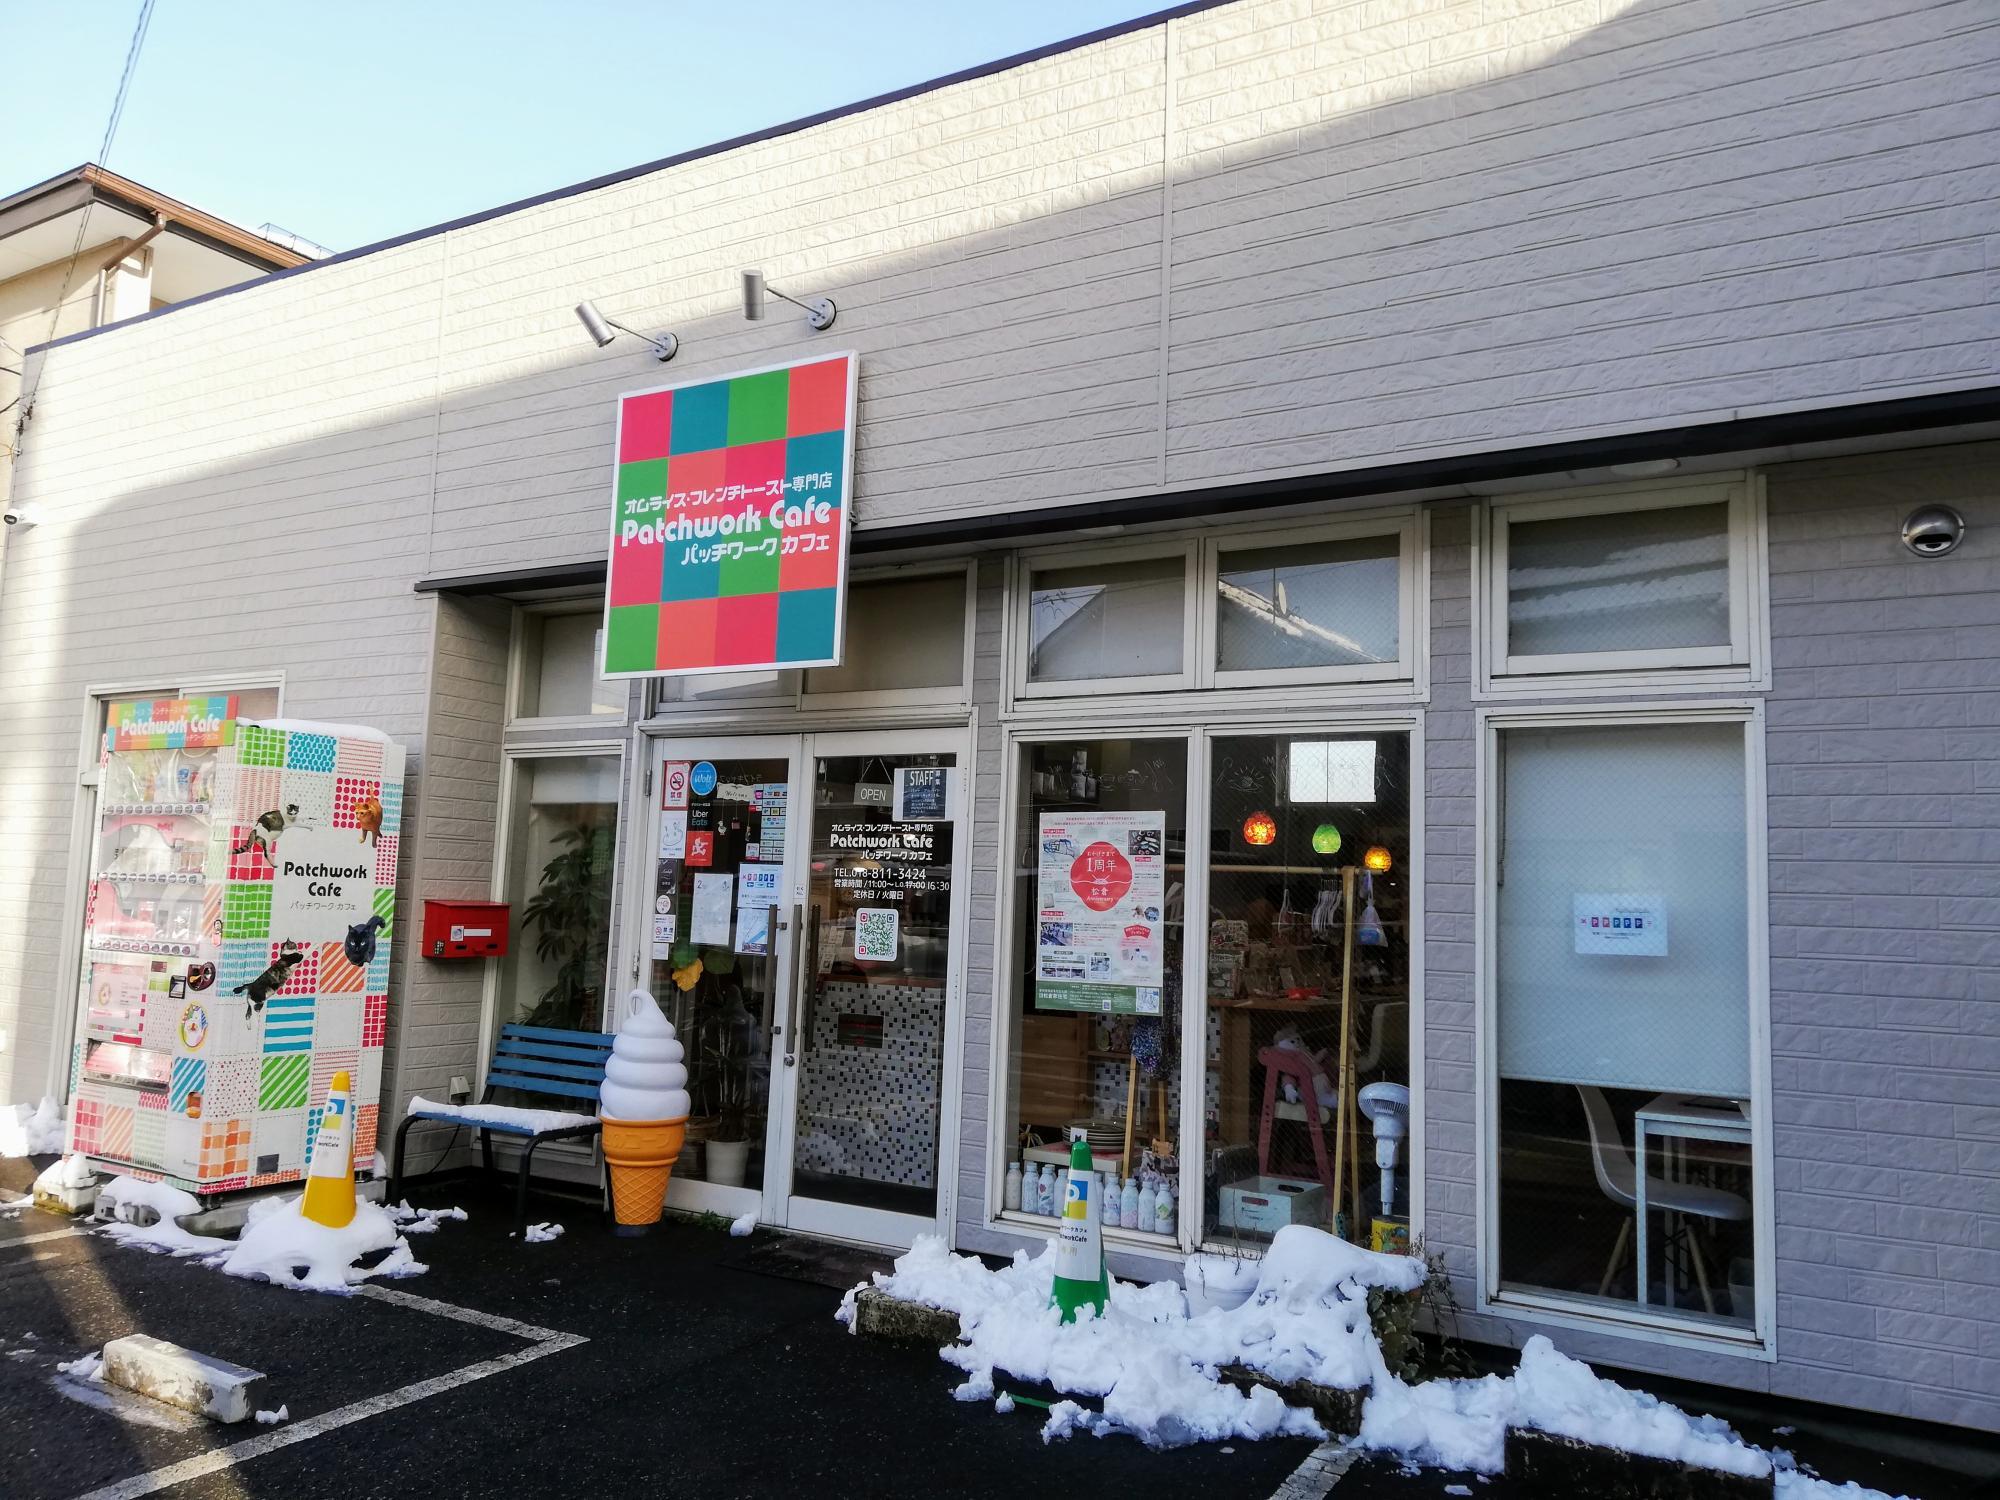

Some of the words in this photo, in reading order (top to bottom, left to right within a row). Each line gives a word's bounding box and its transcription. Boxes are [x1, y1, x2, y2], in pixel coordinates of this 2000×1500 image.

[625, 472, 833, 515] オムライス・フレンチトースト専門店
[621, 504, 761, 547] Patchwork
[769, 495, 832, 530] Cafe
[681, 537, 777, 566] パッチワーク
[780, 532, 830, 555] カフェ
[121, 715, 188, 736] Patchwork
[190, 713, 220, 733] Cafe
[694, 773, 713, 783] Wolt
[909, 770, 935, 786] STAFF
[860, 788, 887, 801] OPEN
[691, 809, 709, 818] Uber
[691, 818, 709, 826] Eats
[831, 823, 934, 832] オムライス・フレンチトースト専門店
[830, 833, 900, 849] Patchwork
[902, 833, 933, 849] Cafe
[860, 849, 907, 860] パッチワーク
[908, 850, 934, 861] カフェ
[283, 861, 367, 879] Patchwork
[1087, 857, 1117, 873] 1周年
[308, 881, 342, 897] Cafe
[834, 879, 863, 889] 営業時間
[853, 890, 875, 899] 定休日
[881, 890, 904, 900] 火曜日
